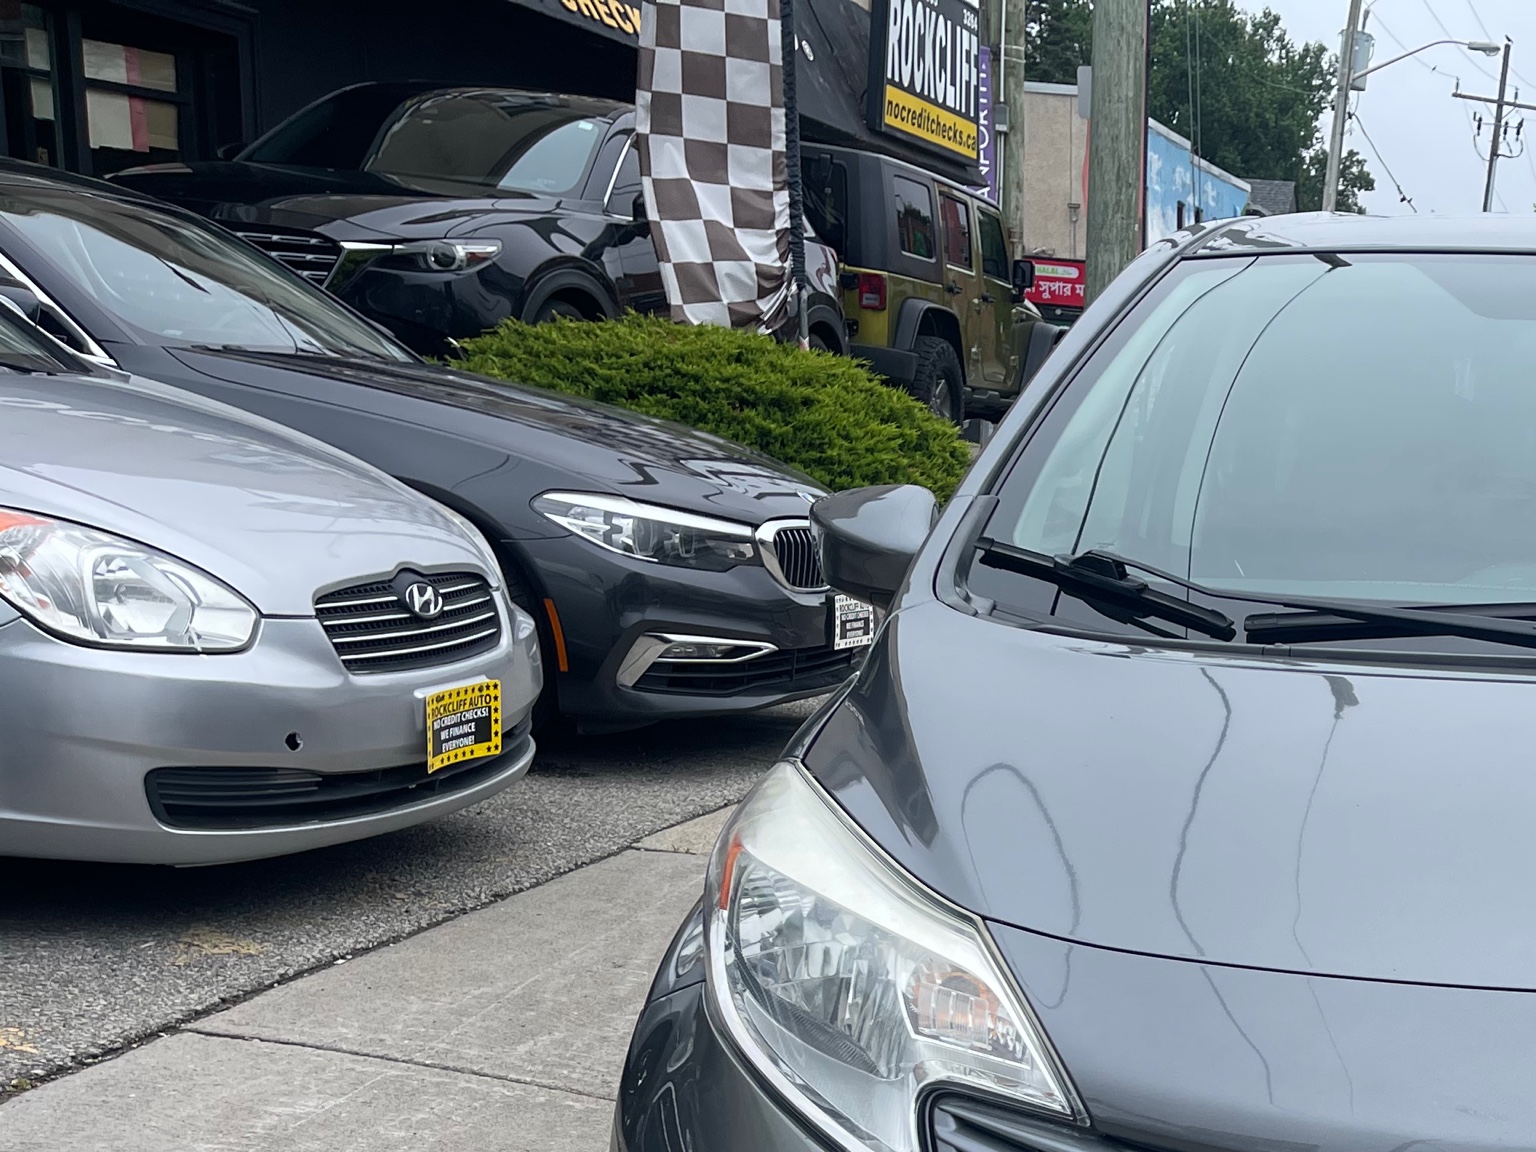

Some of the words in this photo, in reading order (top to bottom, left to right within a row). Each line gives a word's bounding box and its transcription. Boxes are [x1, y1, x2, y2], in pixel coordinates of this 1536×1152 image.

[887, 0, 979, 117] ROCKCLIFF
[886, 98, 978, 151] nocreditchecks.ca
[431, 698, 467, 719] ROCKCLIFF
[468, 694, 492, 709] AUTO
[433, 719, 441, 730] NO
[441, 713, 460, 727] CREDIT
[461, 707, 489, 721] CHECKS!
[440, 729, 449, 740] WE
[450, 722, 476, 737] FINANCE
[442, 735, 475, 753] EVERYONE!
